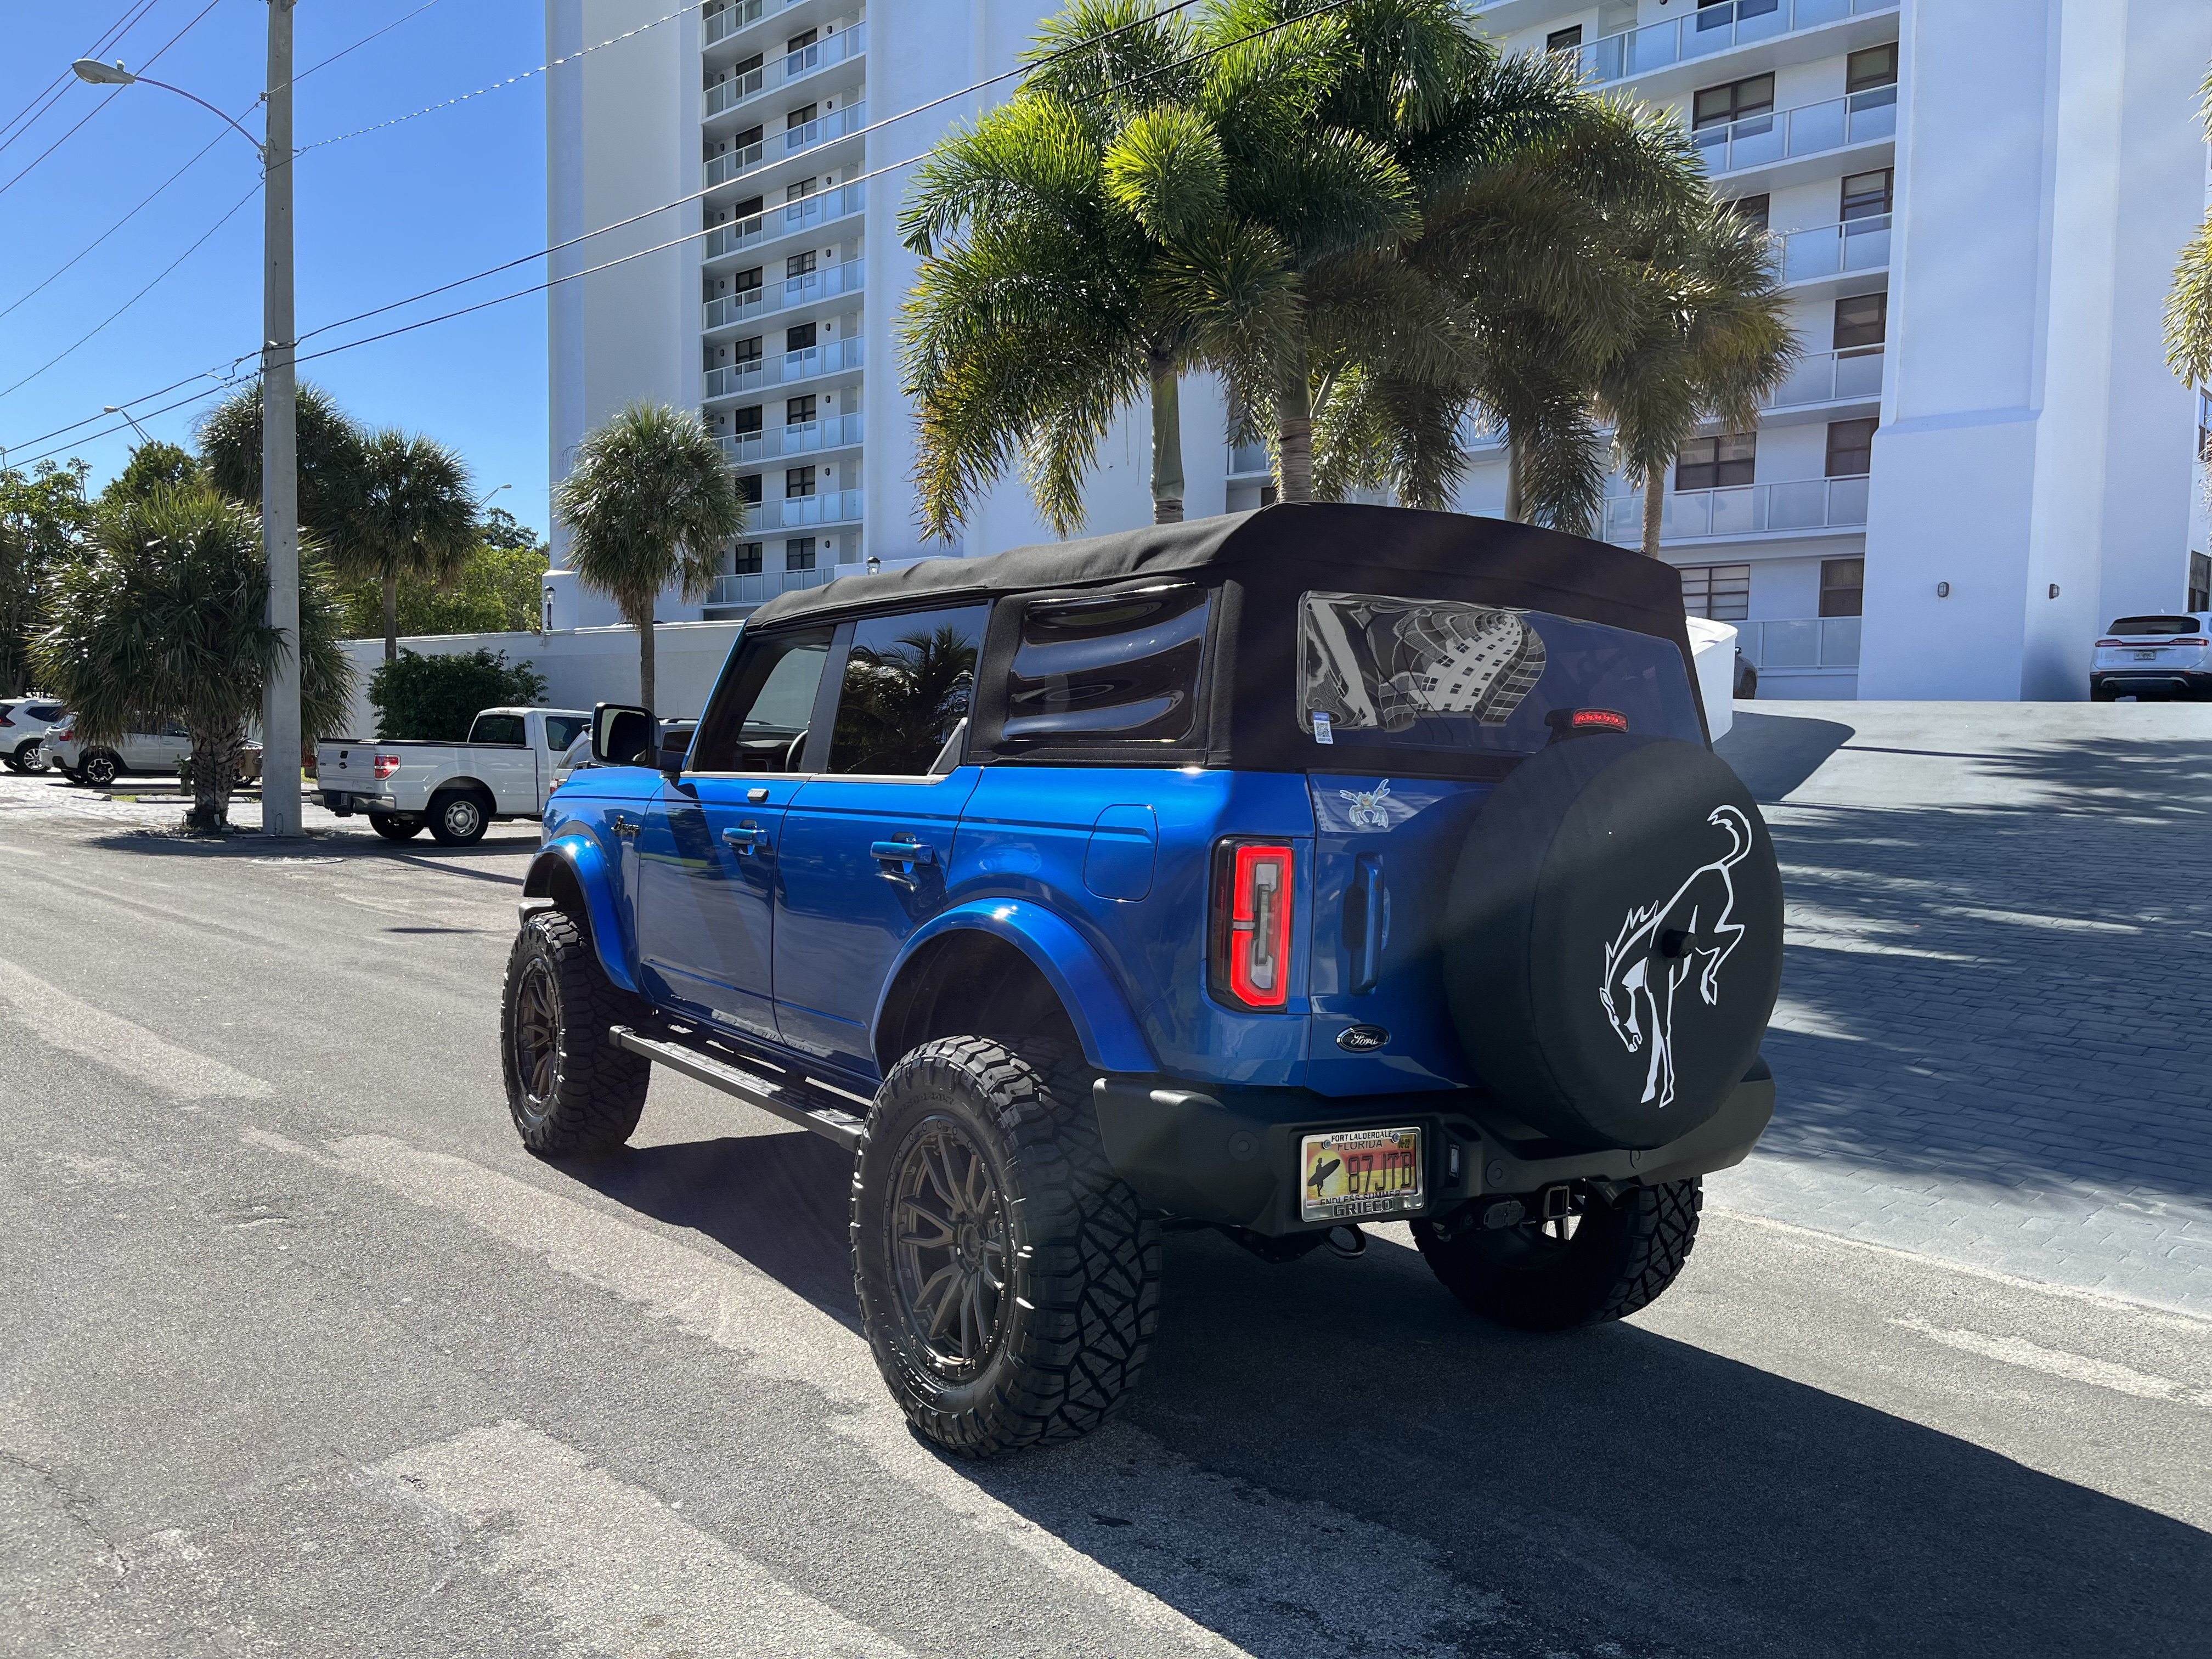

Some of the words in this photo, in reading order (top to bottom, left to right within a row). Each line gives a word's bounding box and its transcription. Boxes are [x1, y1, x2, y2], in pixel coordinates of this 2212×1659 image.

[1350, 1031, 1379, 1046] Ford
[1331, 1133, 1348, 1142] FORT
[1350, 1130, 1392, 1141] LAUDERDALE
[1338, 1139, 1383, 1151] FLORIDA
[1348, 1152, 1412, 1194] 87JTB
[1363, 1190, 1401, 1200] SUMMER
[1333, 1199, 1393, 1216] GRIECO
